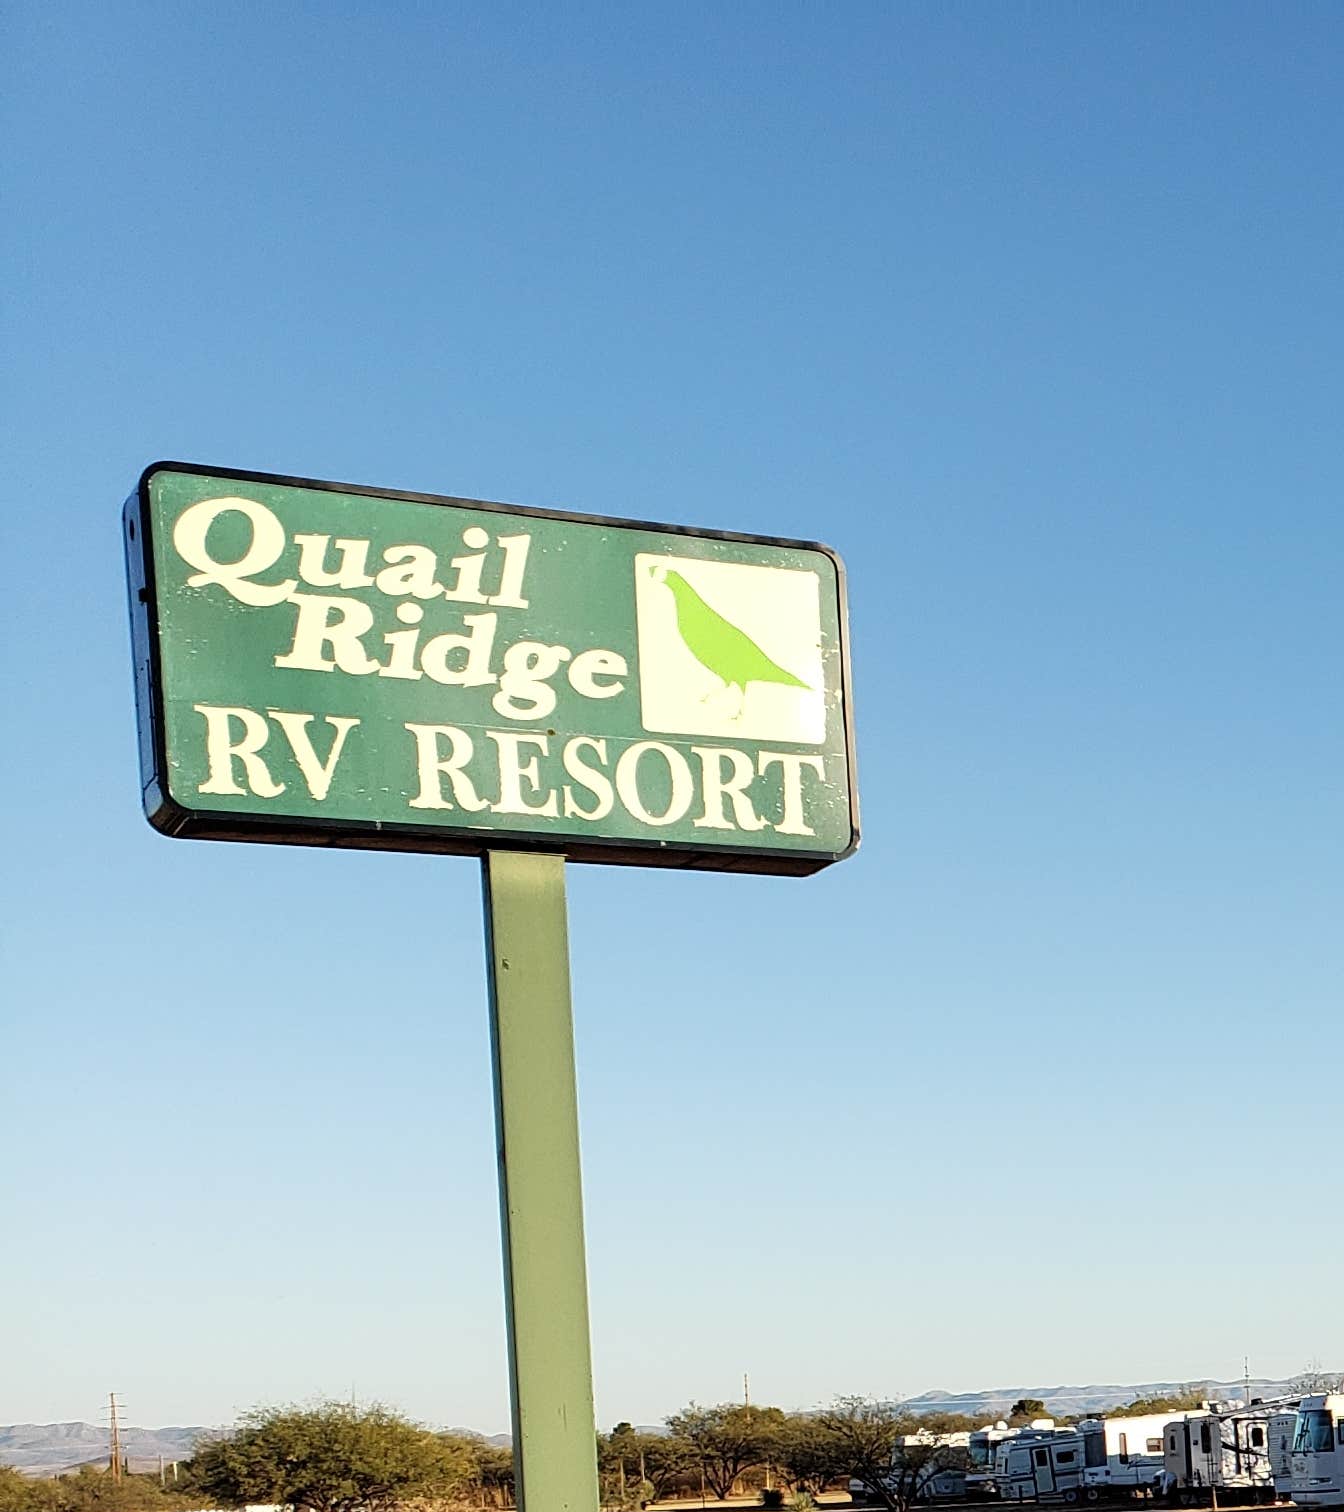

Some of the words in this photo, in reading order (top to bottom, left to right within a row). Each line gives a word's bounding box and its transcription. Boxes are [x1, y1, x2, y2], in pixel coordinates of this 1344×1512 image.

[173, 497, 531, 607] Quail
[275, 594, 628, 719] Ridge
[193, 704, 360, 801] RV
[404, 721, 825, 836] RESORT
